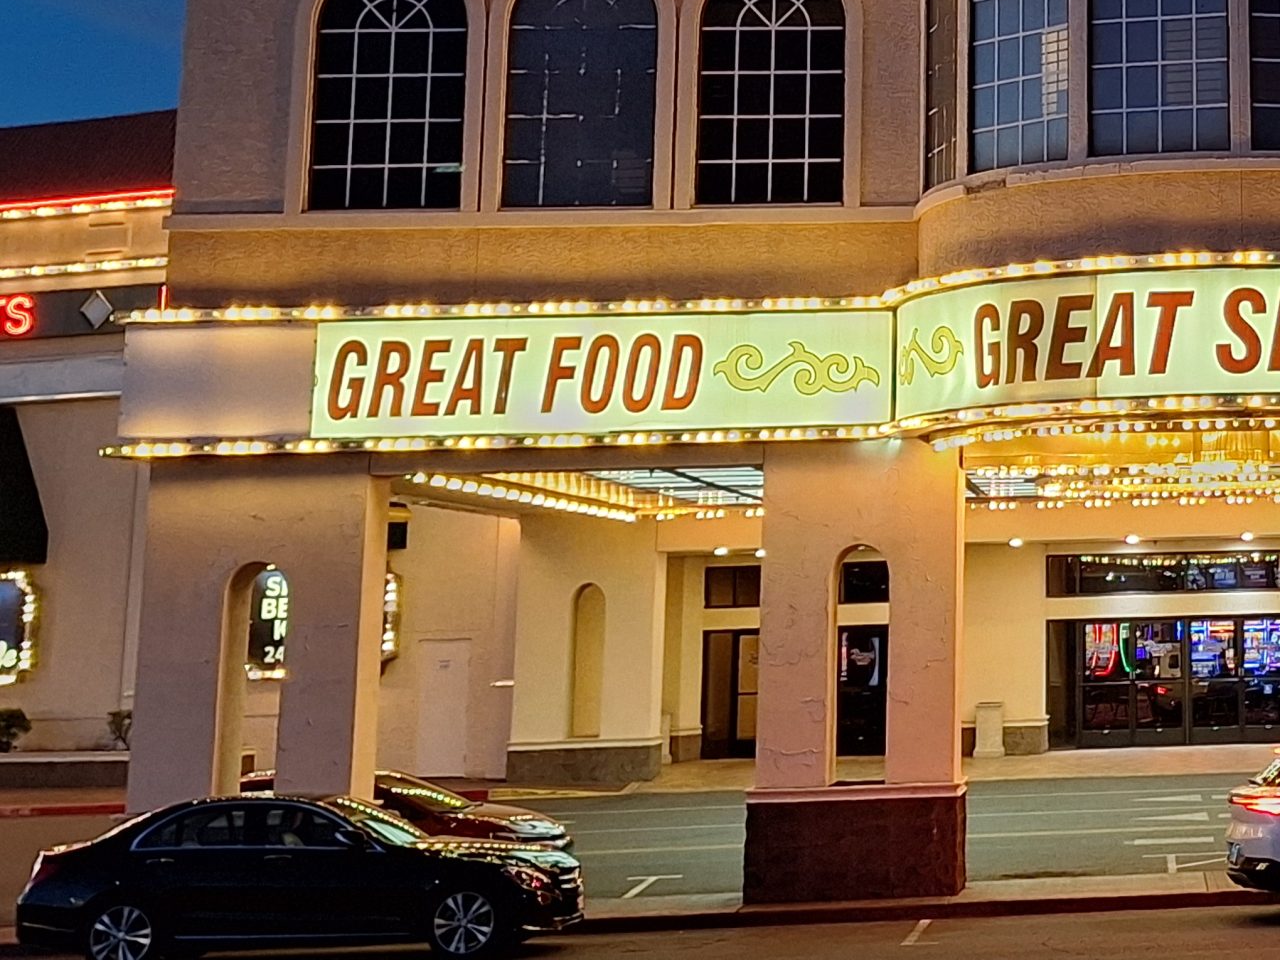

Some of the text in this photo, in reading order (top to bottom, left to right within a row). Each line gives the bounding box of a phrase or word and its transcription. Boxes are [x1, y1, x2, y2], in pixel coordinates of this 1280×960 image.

[326, 333, 704, 421] GREAT FOOD
[972, 289, 1196, 388] GREAT
